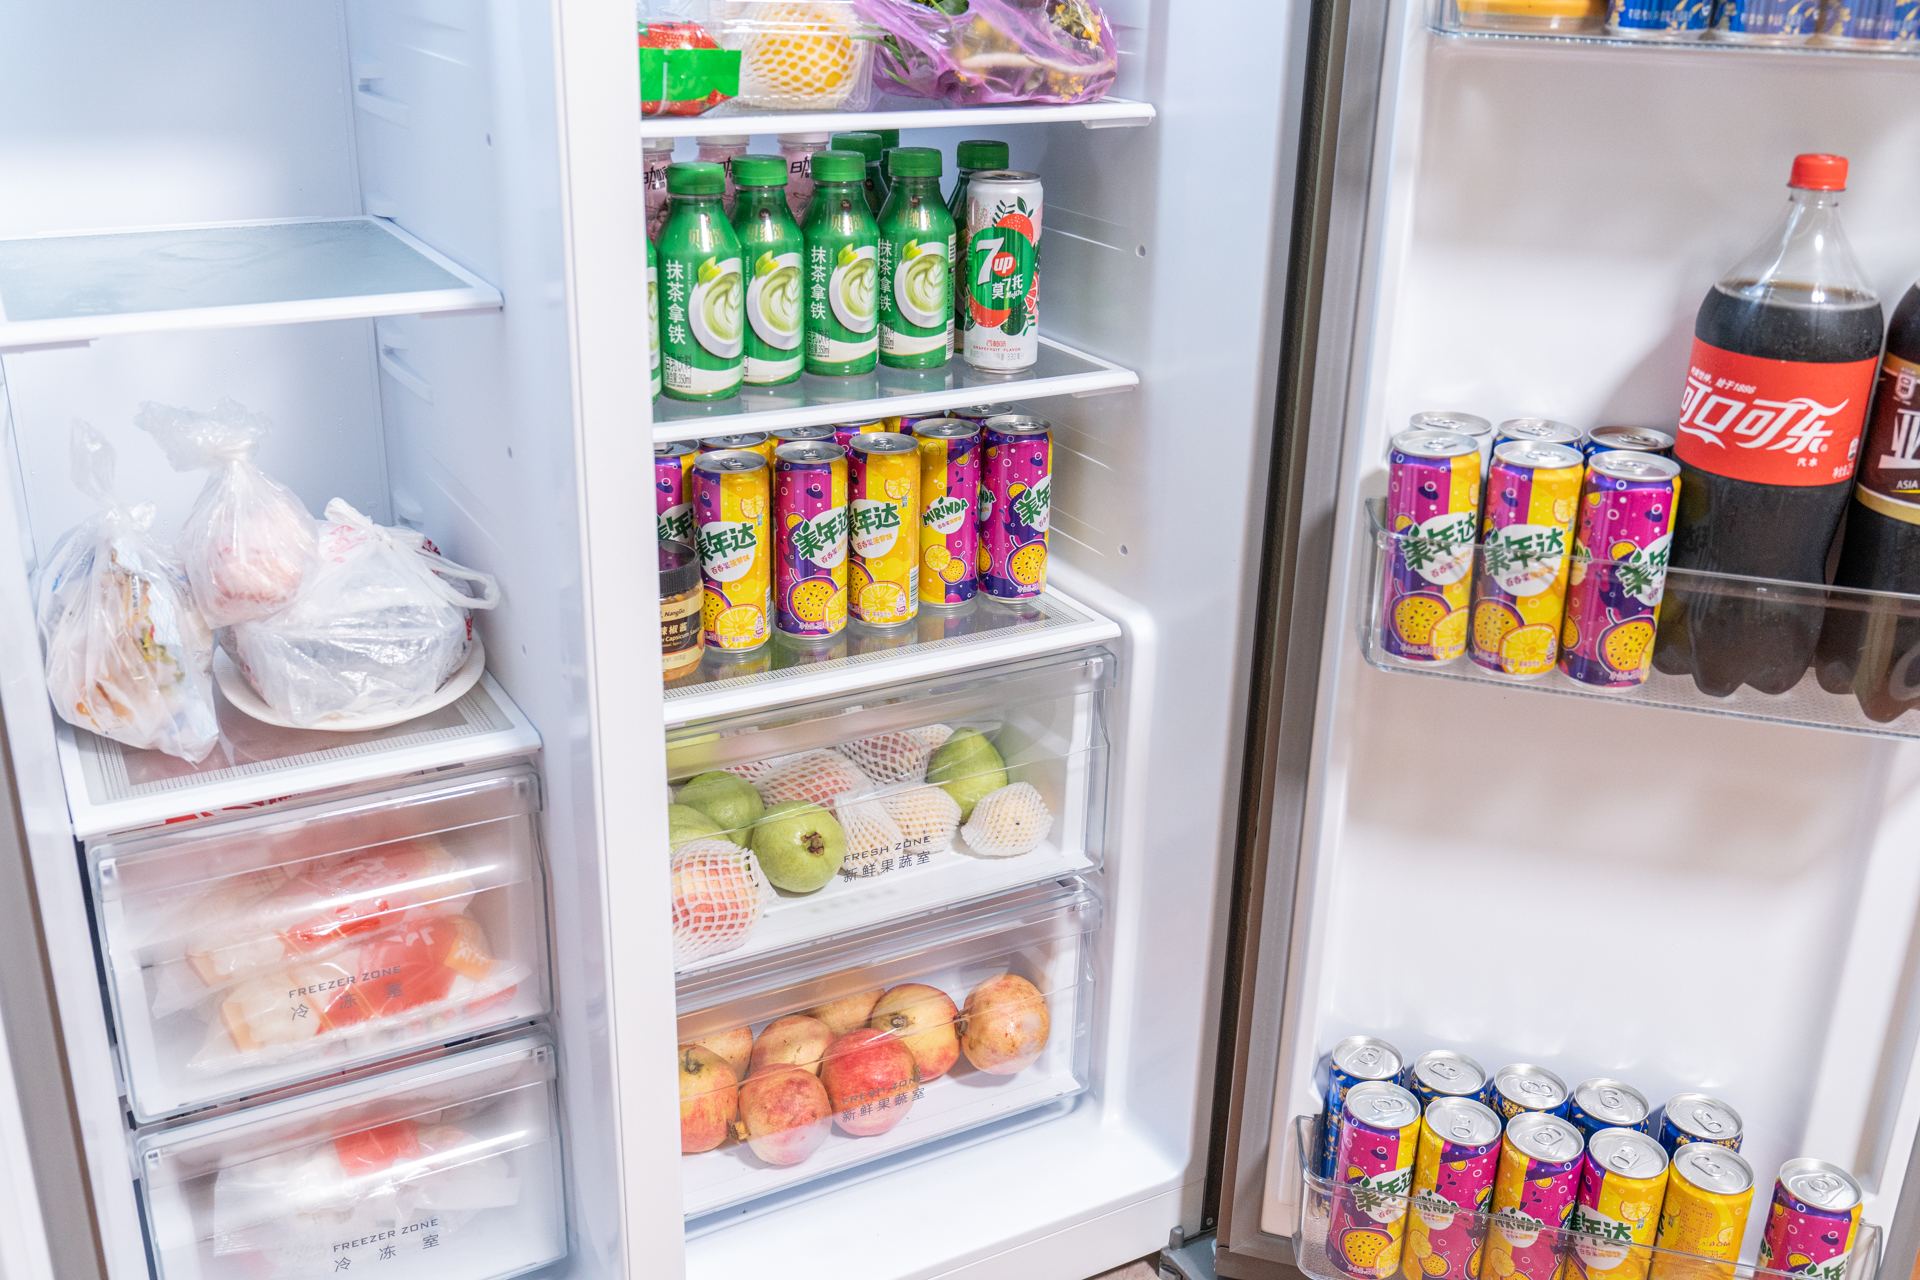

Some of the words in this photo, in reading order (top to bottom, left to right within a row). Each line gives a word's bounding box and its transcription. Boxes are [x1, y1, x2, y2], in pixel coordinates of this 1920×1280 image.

[810, 245, 827, 320] 抹茶拿铁
[880, 239, 893, 312] 抹茶拿铁
[666, 259, 686, 345] 抹茶拿铁
[1679, 376, 1850, 454] 可口可乐
[1896, 479, 1919, 489] ASIA
[922, 498, 969, 527] MIRINDA
[1015, 486, 1050, 526] 美年
[696, 523, 757, 566] 美年达
[1484, 527, 1564, 576] 美年达
[1618, 540, 1671, 597] 美年
[843, 845, 889, 863] FRESH
[894, 835, 931, 851] ZONE
[843, 851, 931, 883] 新鲜果蔬室
[288, 975, 356, 998] FREEZER
[361, 965, 402, 982] ZONE
[290, 982, 404, 1021] 冷冻室
[842, 1086, 886, 1105] FRESH
[891, 1073, 925, 1090] ZONE
[842, 1087, 925, 1123] 新鲜果蔬室
[333, 1230, 396, 1252] FREEZER
[401, 1218, 438, 1235] ZONE
[334, 1234, 440, 1273] 冷冻室
